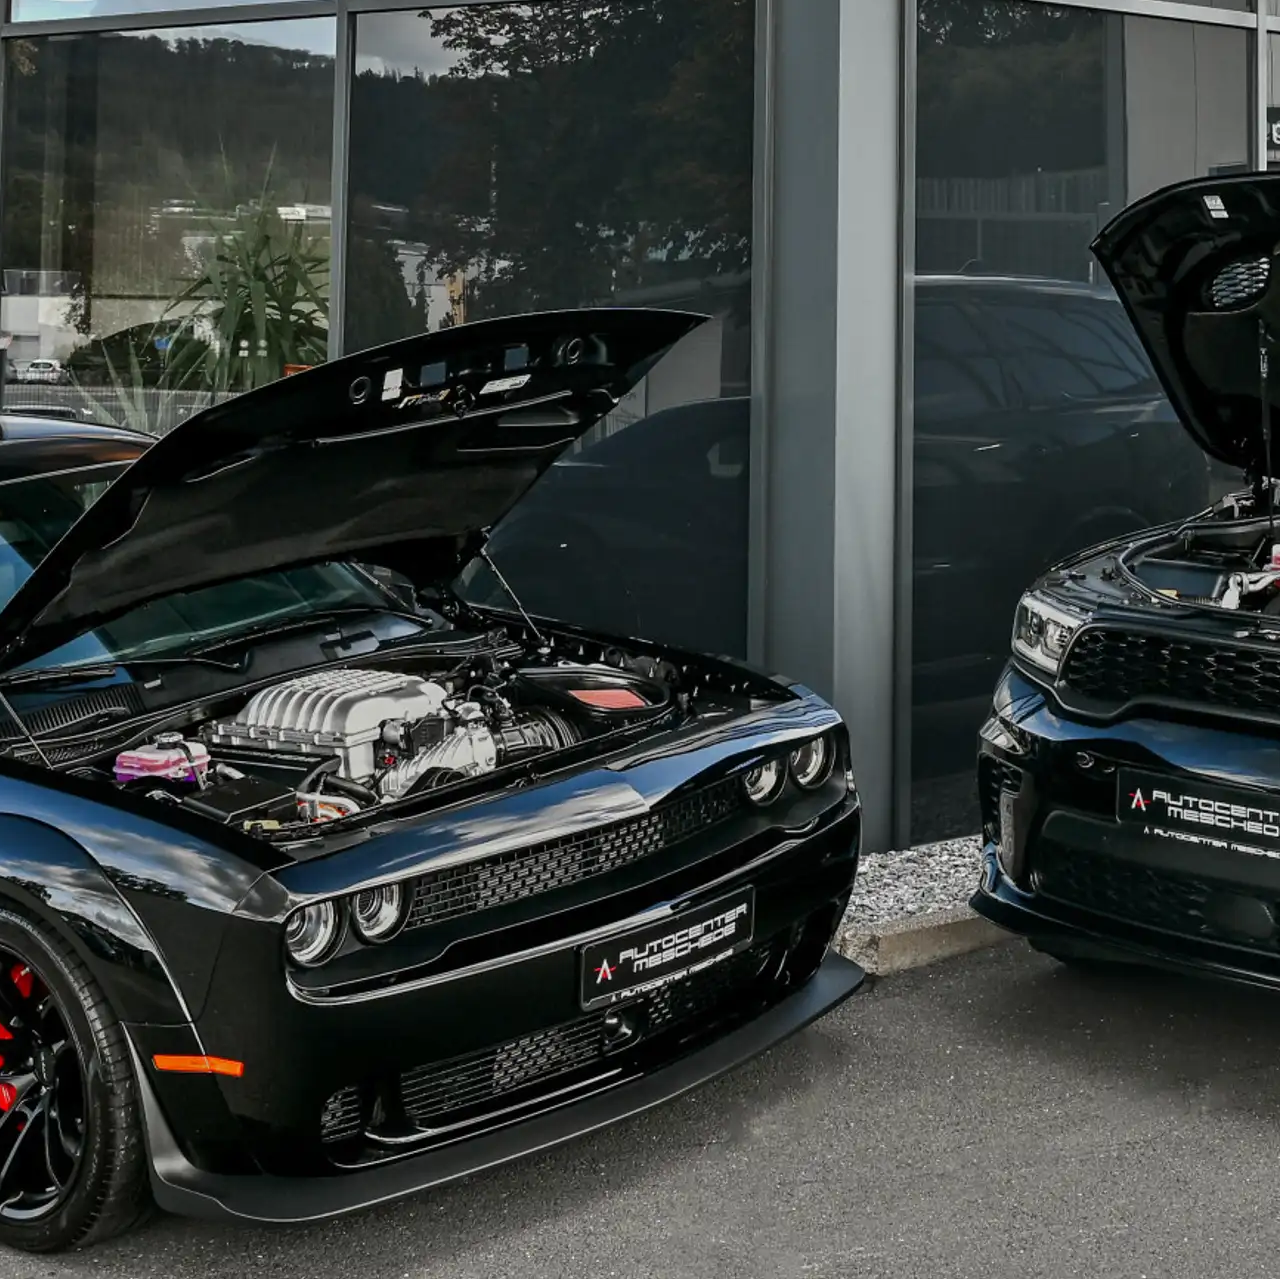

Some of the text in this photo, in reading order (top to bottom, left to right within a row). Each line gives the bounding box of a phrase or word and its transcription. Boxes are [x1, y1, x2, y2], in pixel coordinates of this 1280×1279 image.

[1153, 828, 1228, 850] AUTOCENTER
[619, 902, 748, 964] AUTOCENTER
[633, 921, 736, 974] MESCHEDE
